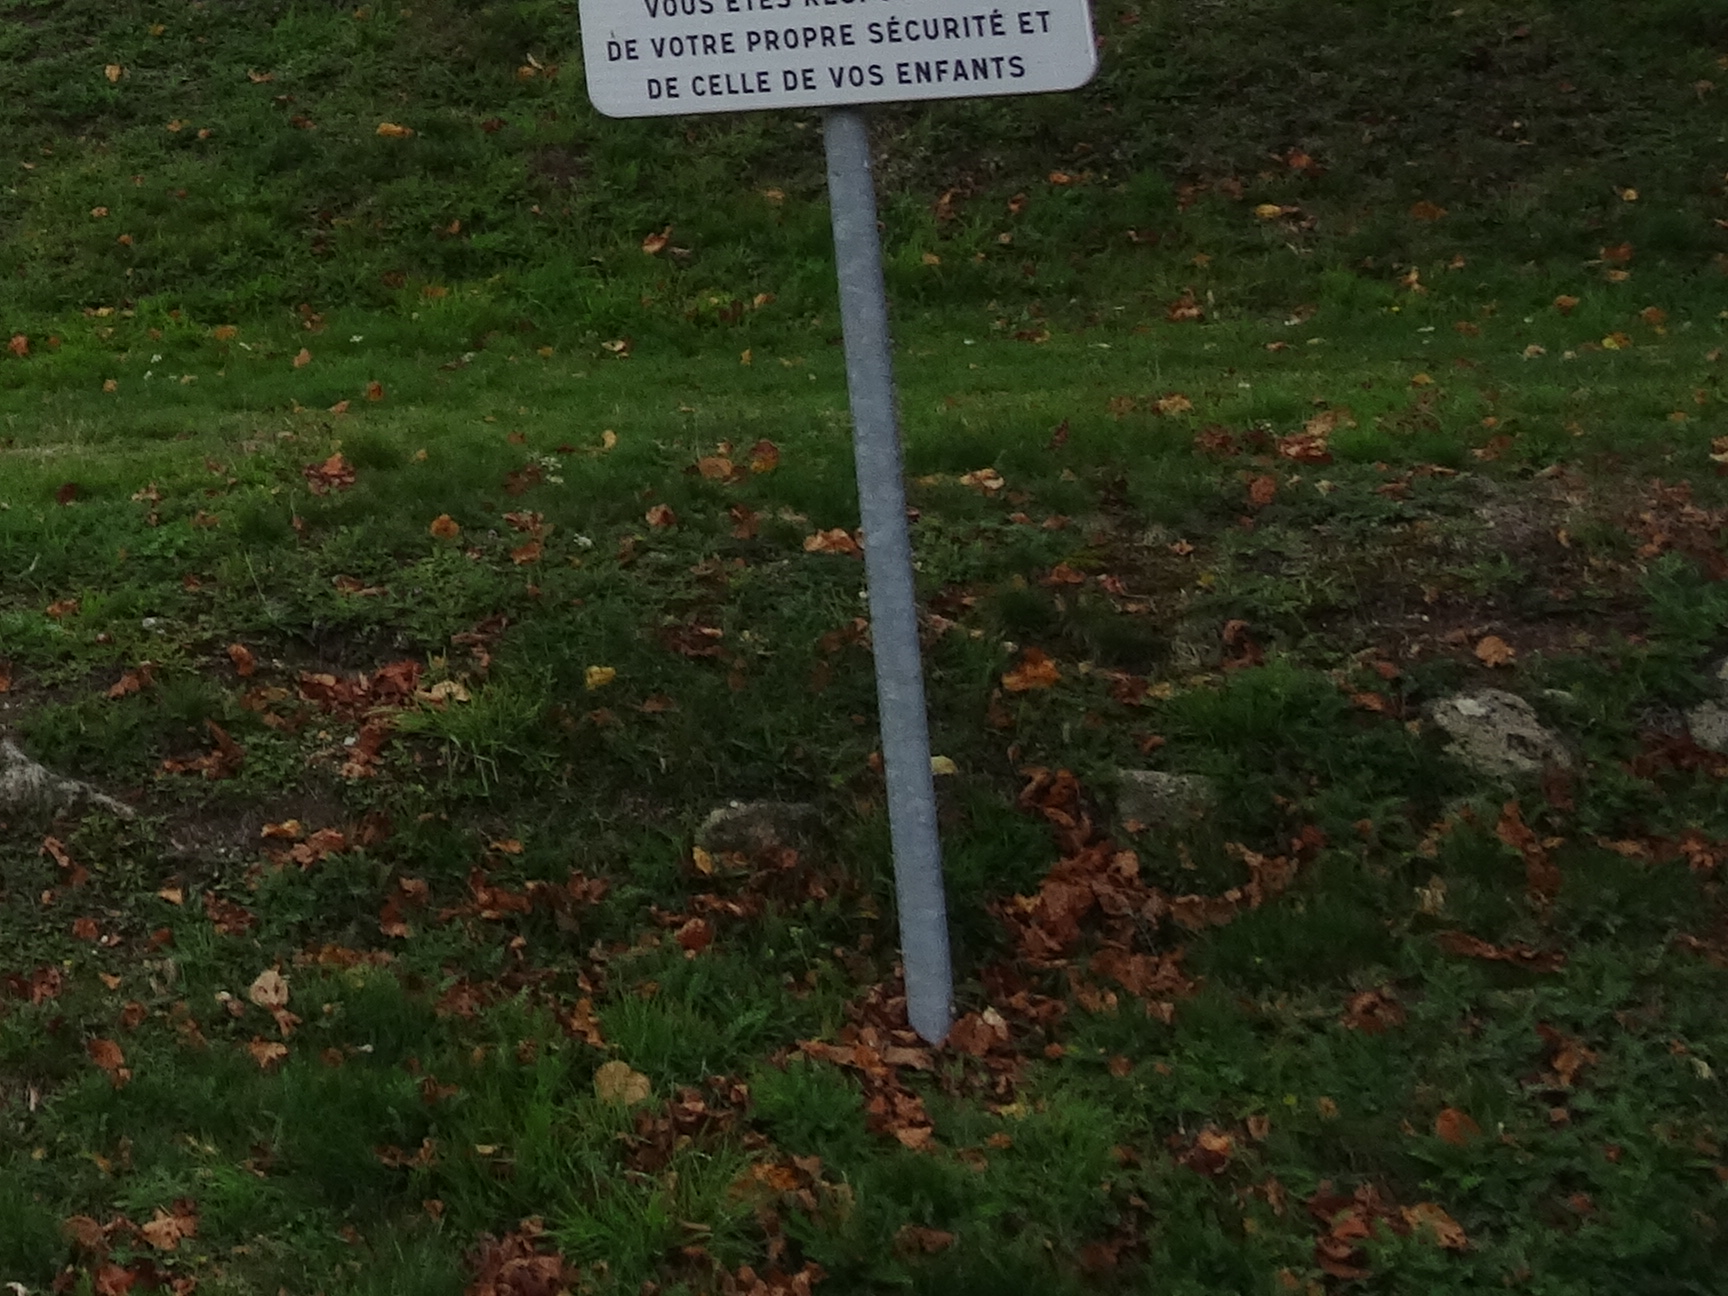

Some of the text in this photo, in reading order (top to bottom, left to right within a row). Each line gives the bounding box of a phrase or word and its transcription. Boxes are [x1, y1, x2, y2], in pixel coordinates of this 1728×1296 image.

[607, 8, 1051, 62] DE VOTRE PROPRE SÉCURITÉ ET
[647, 55, 1026, 100] DE CELLE DE VOS ENFANTS
